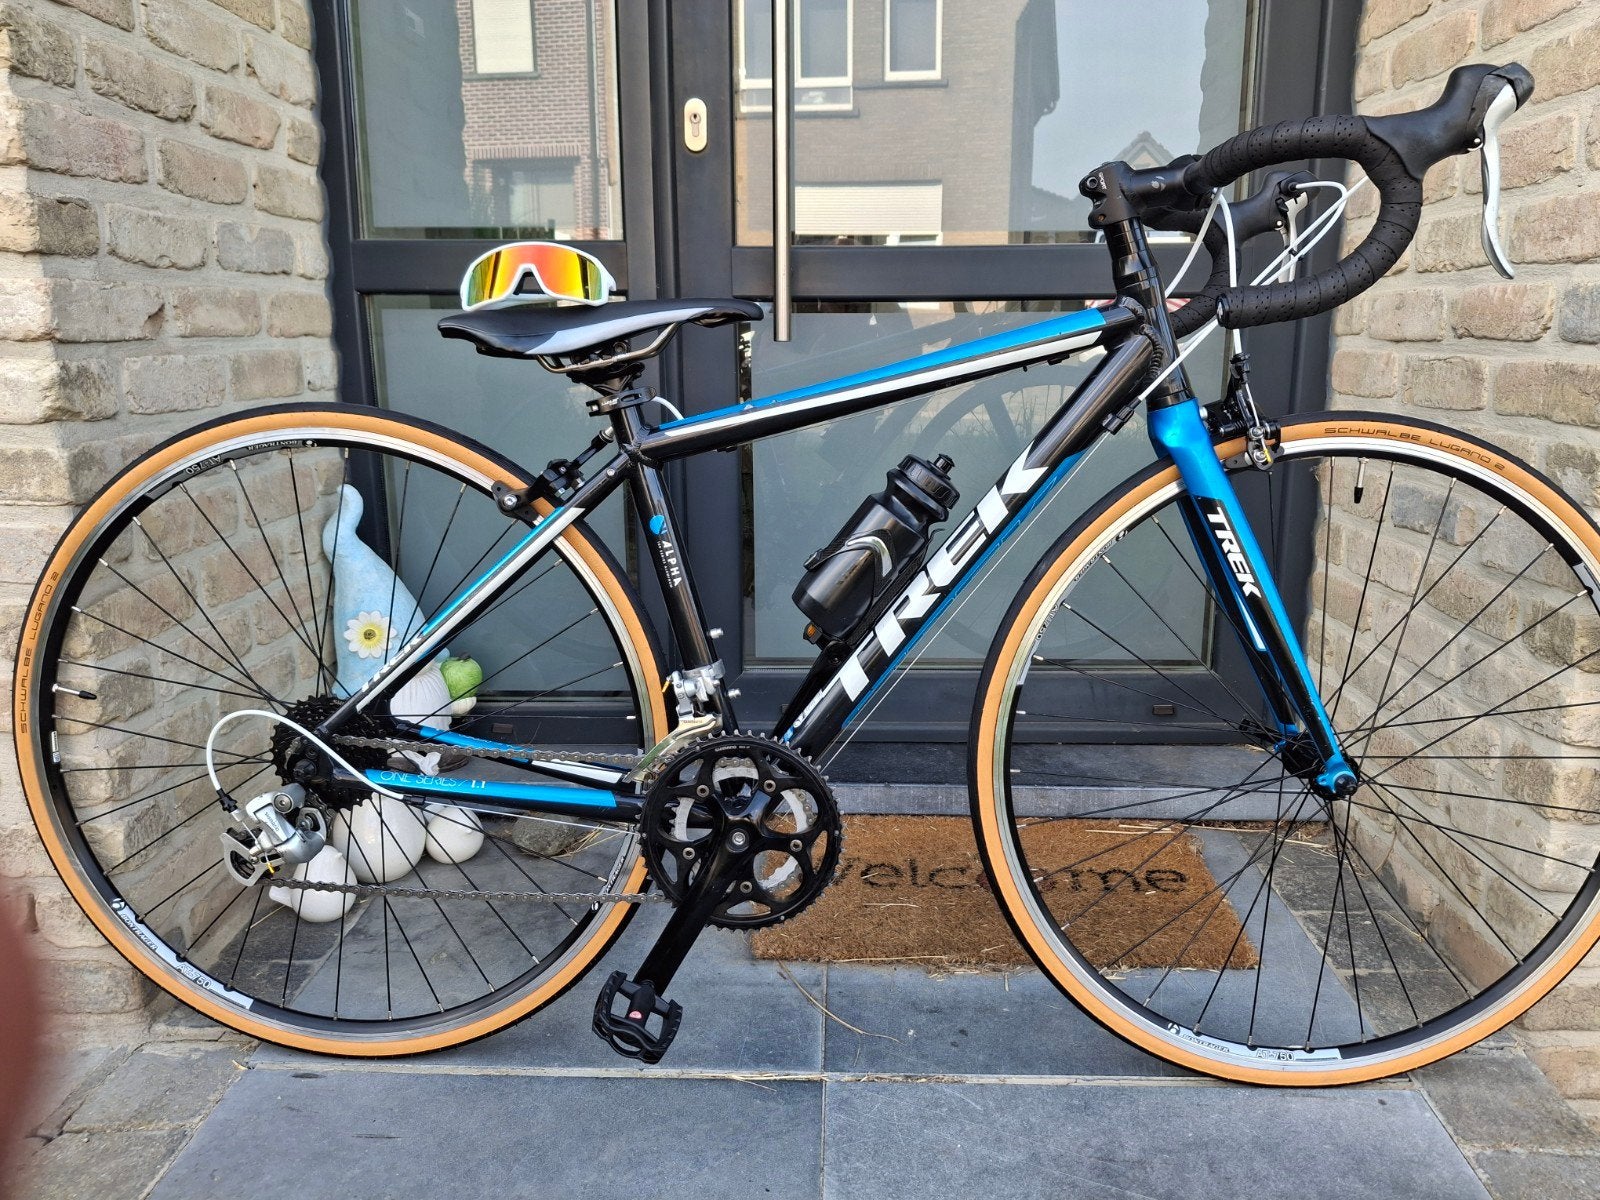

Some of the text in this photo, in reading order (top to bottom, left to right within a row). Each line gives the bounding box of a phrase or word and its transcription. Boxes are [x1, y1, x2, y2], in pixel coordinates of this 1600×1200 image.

[1324, 427, 1506, 471] SCHWALBE LUGANO 2
[662, 540, 682, 587] ALPHA
[822, 439, 1049, 702] TREK
[1207, 506, 1262, 598] TREK
[20, 571, 60, 733] SCHWALBE LUGANO 2
[380, 771, 411, 782] ONE
